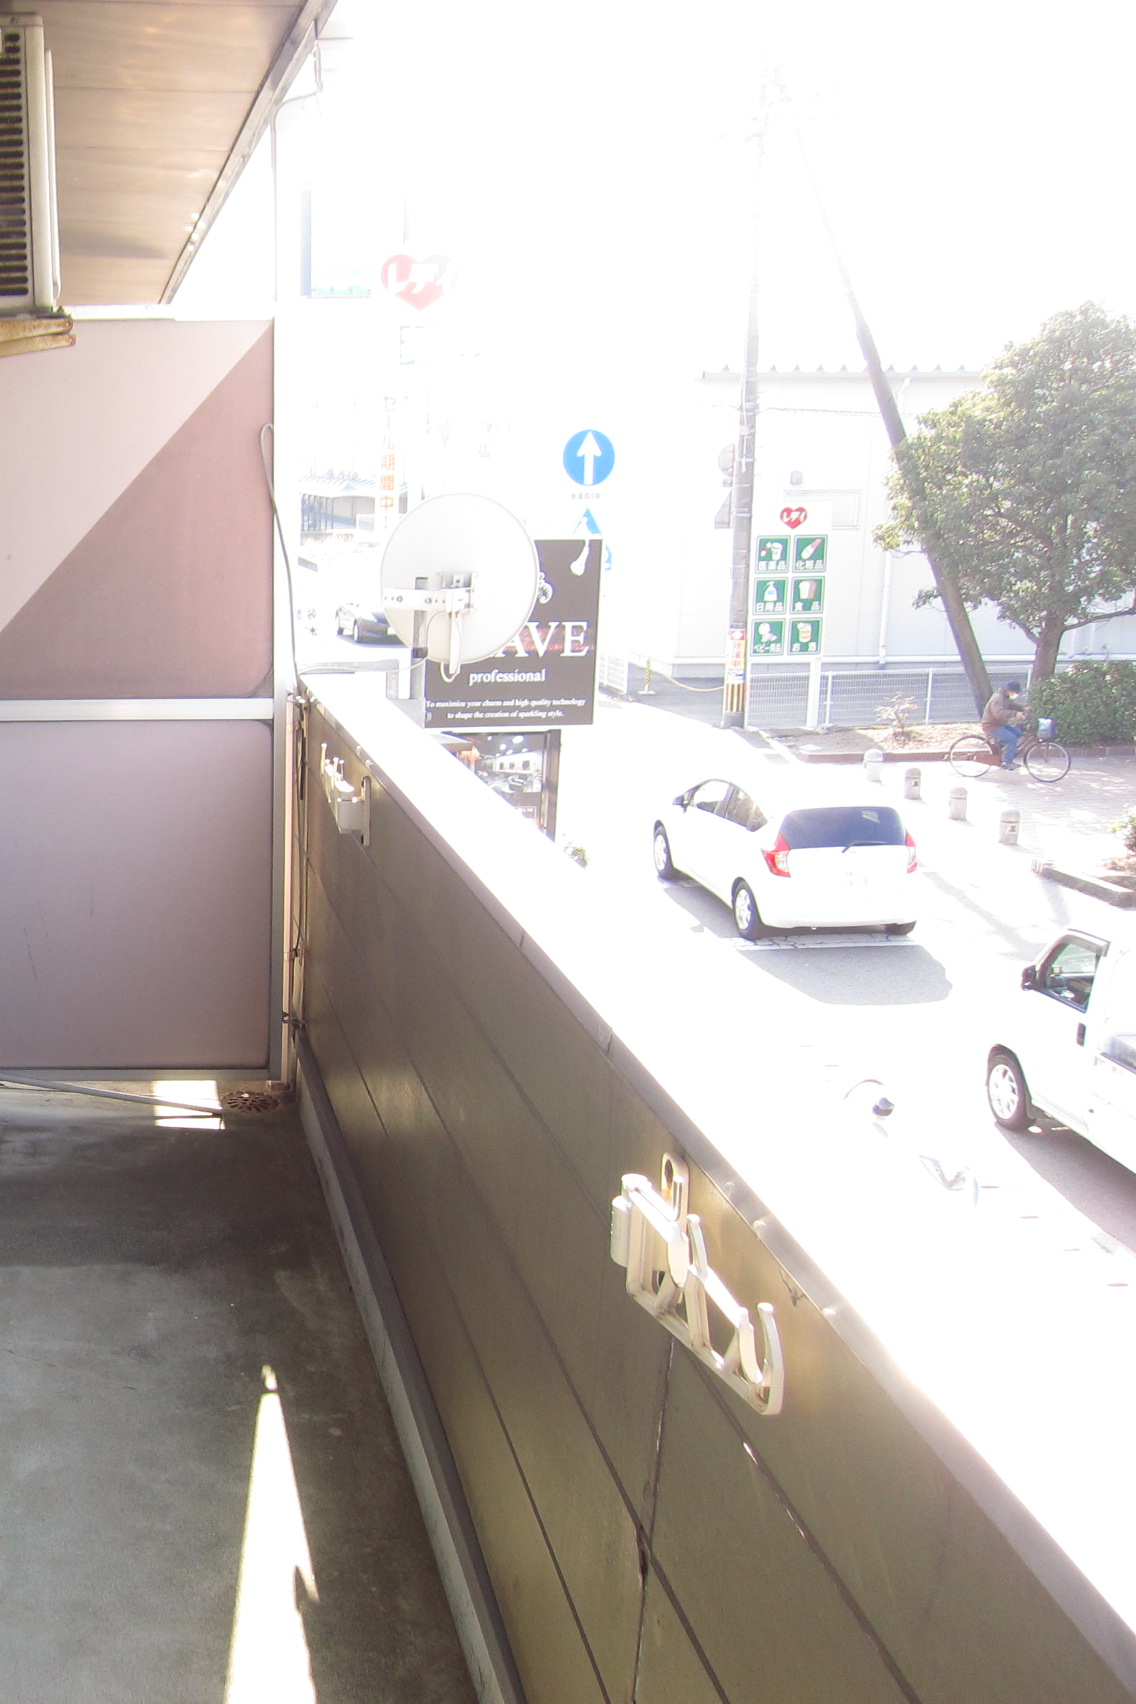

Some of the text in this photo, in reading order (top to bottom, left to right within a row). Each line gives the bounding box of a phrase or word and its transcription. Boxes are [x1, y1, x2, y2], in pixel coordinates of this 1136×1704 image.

[796, 559, 824, 570] 化粧品
[756, 602, 784, 612] 日用品
[491, 620, 590, 658] AVE
[469, 668, 546, 687] professional
[426, 697, 586, 709] To maximize your charm and high quality technology
[455, 711, 473, 720] shape
[484, 710, 510, 718] creation
[510, 709, 519, 717] of
[518, 709, 547, 719] sparkling
[547, 709, 565, 719] style.
